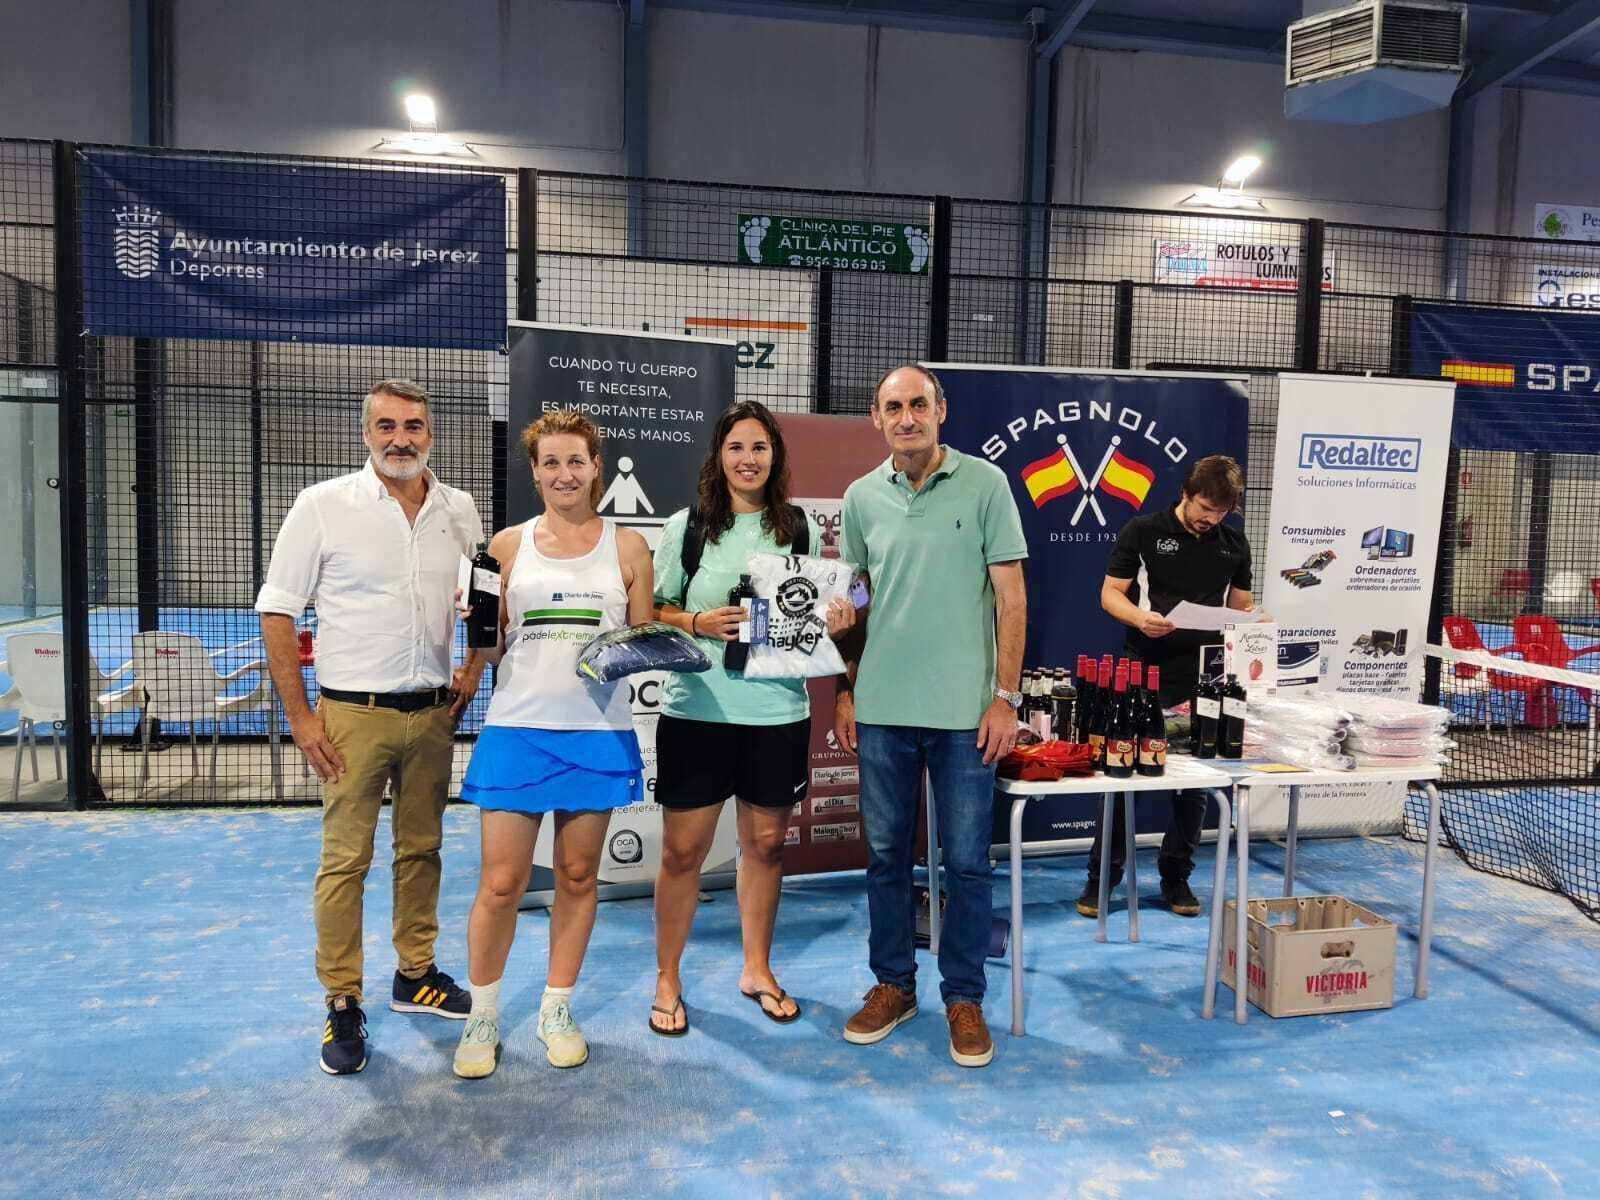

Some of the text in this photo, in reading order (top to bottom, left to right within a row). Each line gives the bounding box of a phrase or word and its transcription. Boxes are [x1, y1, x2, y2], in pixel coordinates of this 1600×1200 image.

[841, 224, 868, 236] DEL
[871, 225, 896, 238] PIE
[169, 231, 367, 259] Ayuntamiento
[373, 239, 405, 261] de
[778, 234, 897, 256] ATLÁNTICO
[1217, 244, 1291, 263] ROTULOS Y
[170, 258, 265, 281] Deportes
[832, 257, 849, 269] 30
[1256, 263, 1332, 281] LUMINS
[549, 356, 698, 379] CUANDO TU CUERPO
[577, 380, 672, 400] TE NECESITA,
[541, 401, 705, 422] ES IMPORTANTE ESTAR
[594, 426, 636, 440] ENAS
[981, 400, 1189, 464] SPAGNOLO
[1308, 440, 1412, 468] Redaltec
[1297, 476, 1417, 490] Soluciones Informáticas
[1050, 532, 1091, 542] DESDE
[1281, 526, 1346, 536] Consumibles
[1355, 565, 1417, 576] Ordenadores
[1277, 627, 1337, 638] paraciones
[1344, 661, 1408, 671] Componentes
[1306, 971, 1367, 993] VICTORIA
